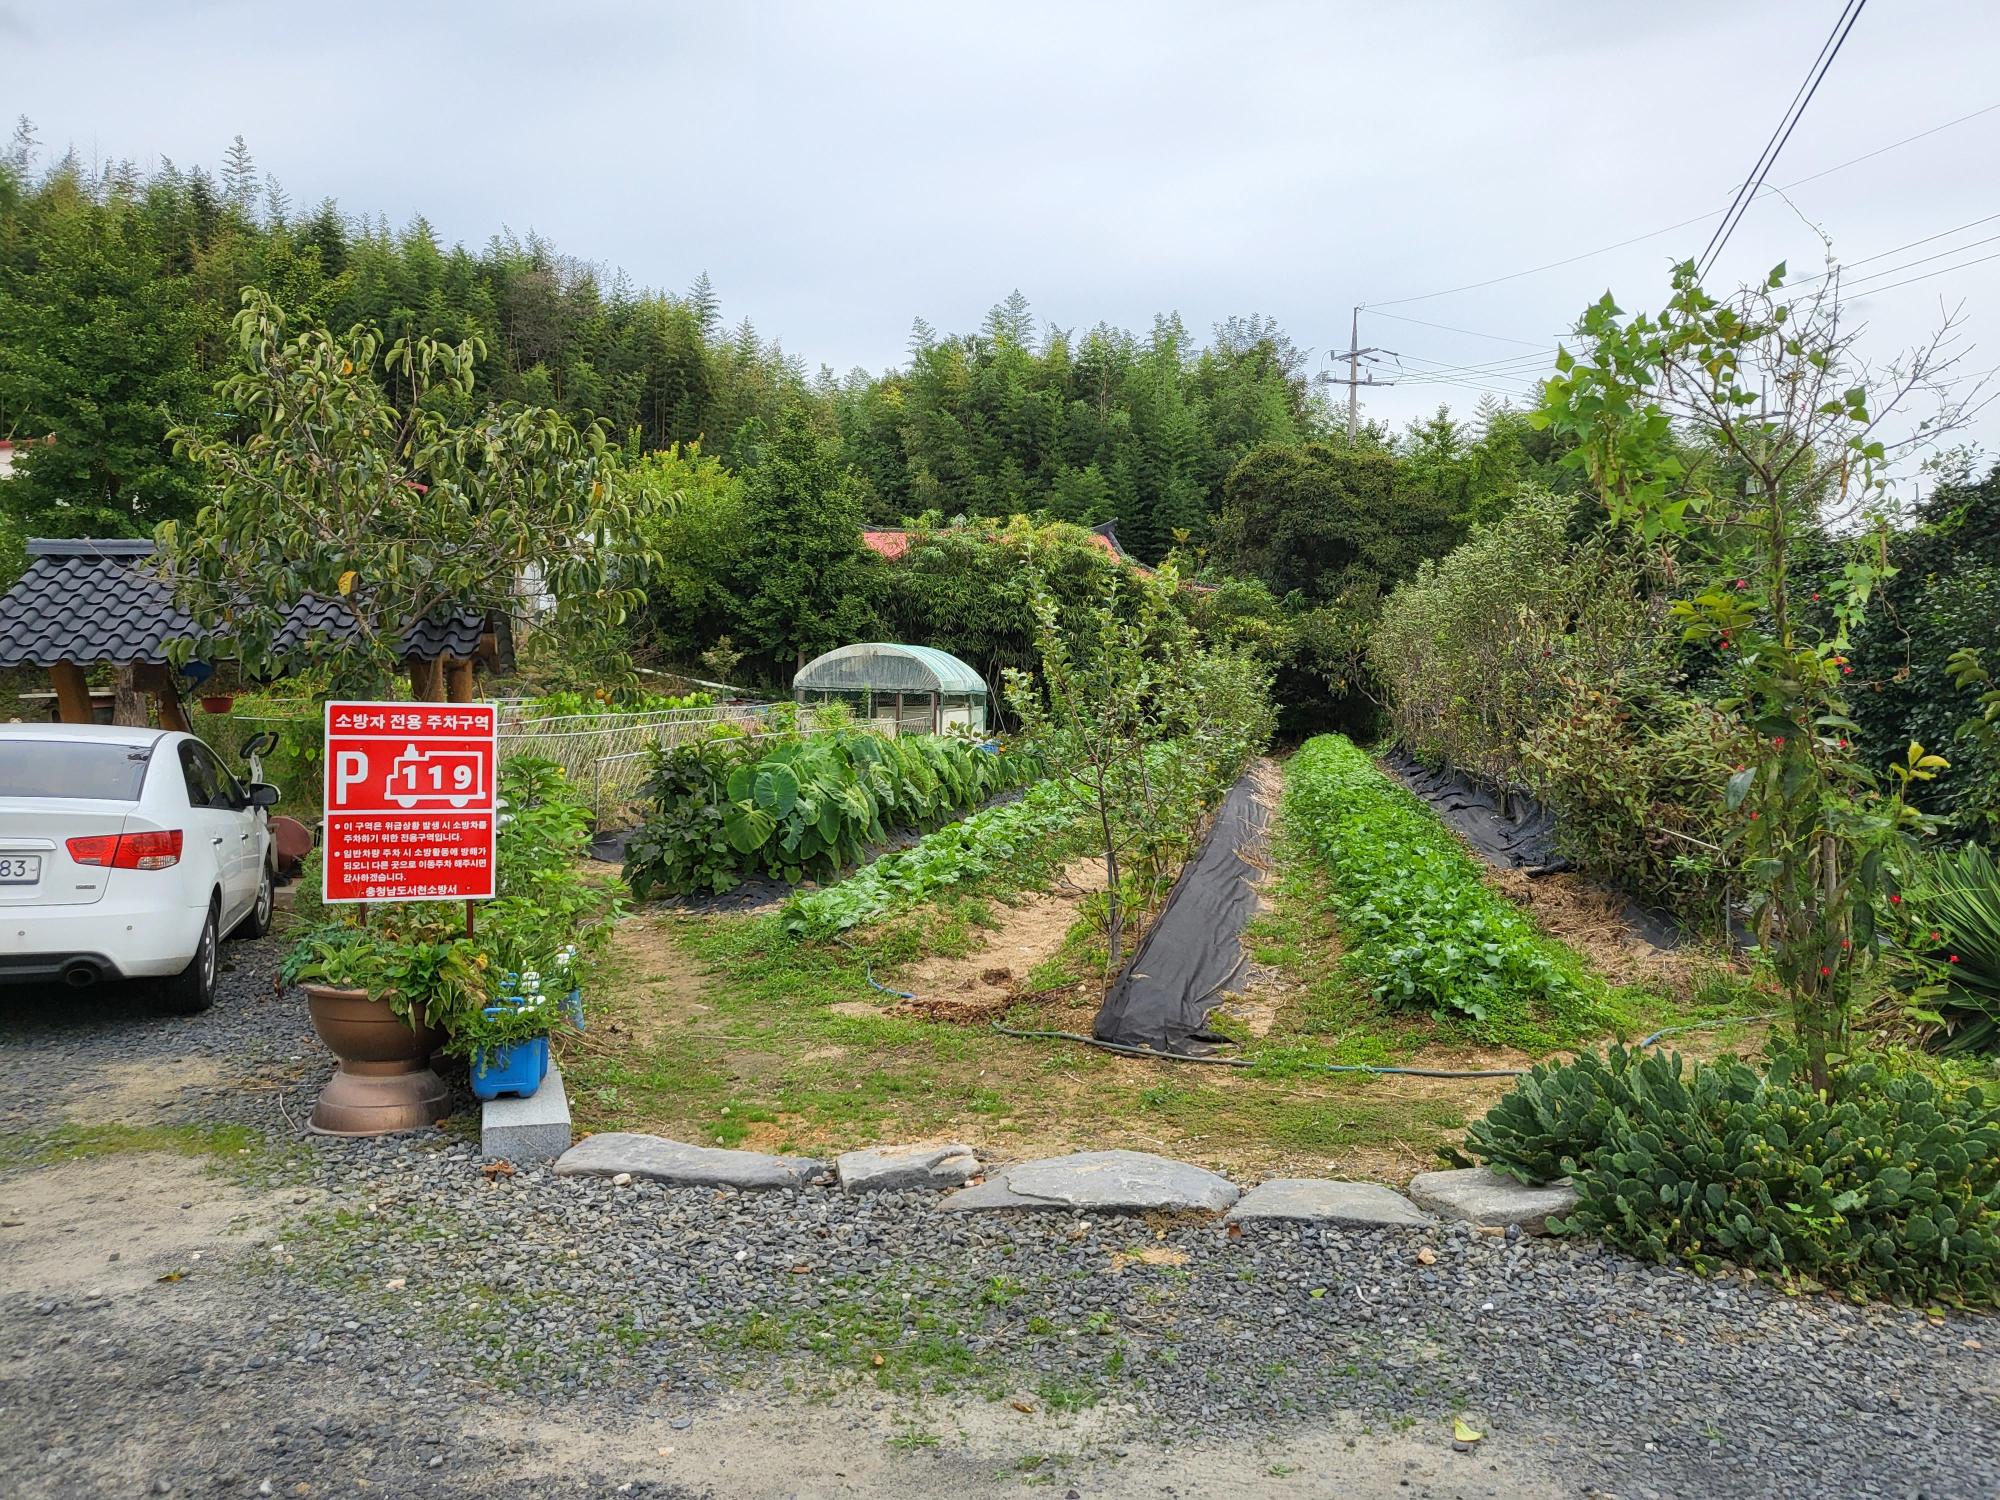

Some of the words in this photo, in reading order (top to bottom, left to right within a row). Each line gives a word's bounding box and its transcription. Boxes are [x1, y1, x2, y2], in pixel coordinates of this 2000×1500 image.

[390, 714, 422, 730] 전용
[427, 715, 489, 730] 주차구역
[336, 751, 368, 804] P
[402, 765, 472, 790] 119
[343, 822, 353, 831] 이
[355, 821, 383, 831] 구역은
[385, 821, 420, 831] 위급상황
[422, 820, 440, 830] 발생
[442, 821, 450, 830] 시
[453, 820, 487, 830] 소방차를
[343, 833, 379, 843] 주차하기
[381, 833, 398, 843] 위한
[343, 849, 380, 859] 일반차량
[382, 848, 400, 857] 주차
[403, 848, 412, 857] 시
[414, 847, 459, 857] 소방활동에
[460, 846, 487, 856] 방해가
[343, 861, 370, 871] 되오니
[371, 860, 389, 870] 다른
[391, 860, 417, 870] 곳으로
[418, 859, 453, 869] 이동주차
[454, 858, 487, 868] 해주시면
[343, 873, 407, 883] 감사하겠습니다.
